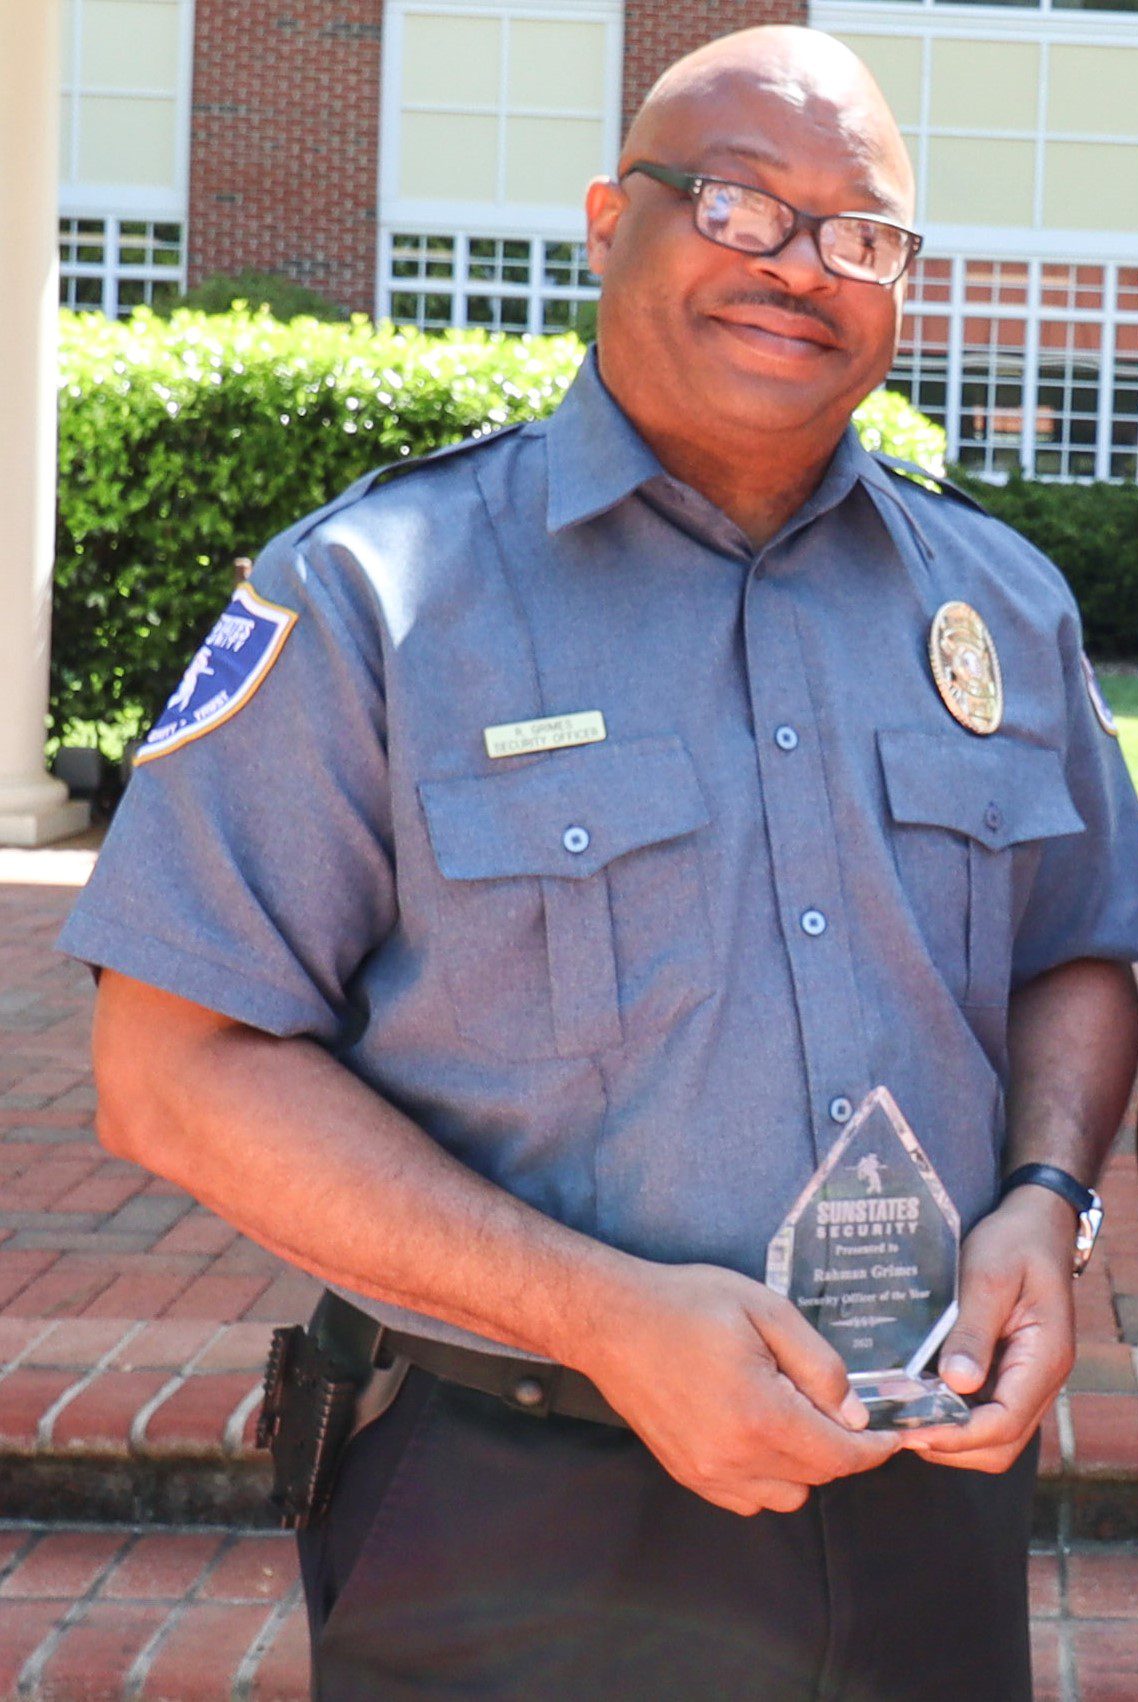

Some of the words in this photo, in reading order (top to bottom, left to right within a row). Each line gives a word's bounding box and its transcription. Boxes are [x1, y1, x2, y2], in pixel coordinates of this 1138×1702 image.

[494, 735, 547, 753] SECURITY
[554, 727, 599, 743] OFFICER
[816, 1196, 920, 1225] SUNSTATES
[816, 1221, 919, 1240] SECURITY
[835, 1243, 886, 1257] Presented
[887, 1243, 900, 1254] to
[814, 1267, 868, 1282] Rahman
[870, 1264, 919, 1280] Grimes
[798, 1295, 839, 1308] Security
[841, 1291, 878, 1304] Officer
[880, 1289, 890, 1301] of
[891, 1290, 907, 1301] the
[908, 1288, 932, 1299] Year
